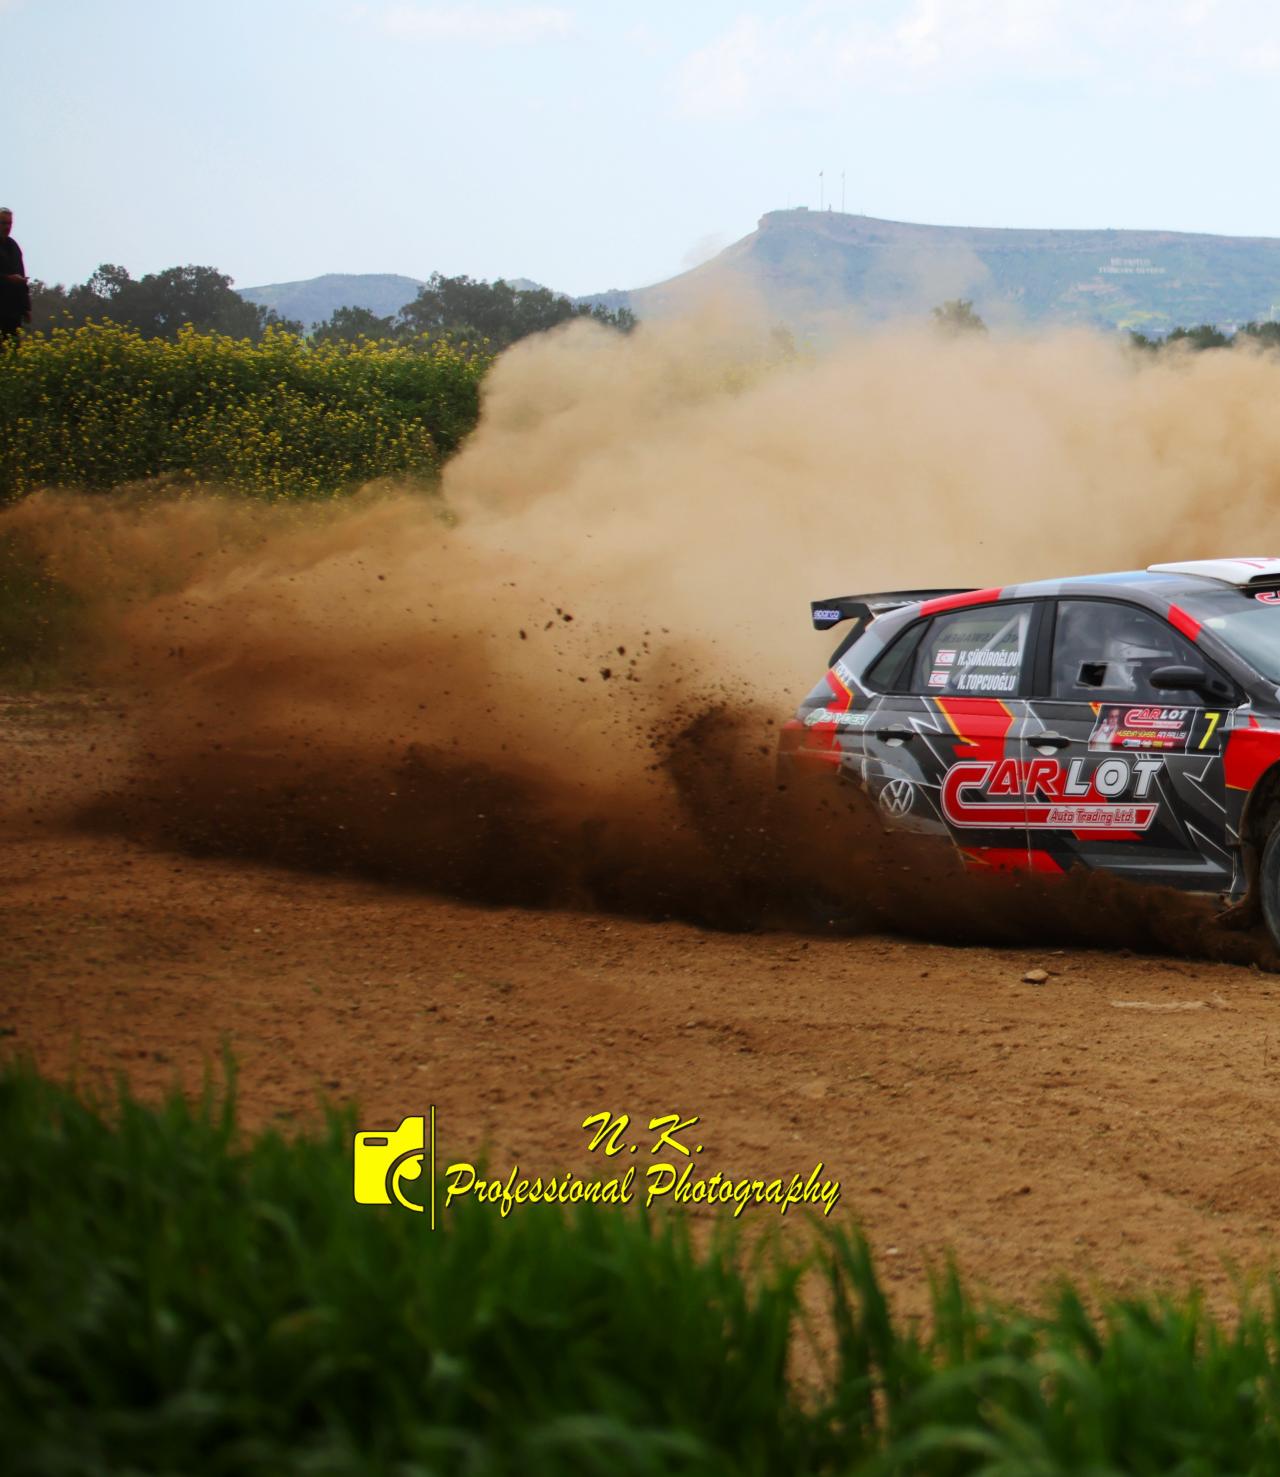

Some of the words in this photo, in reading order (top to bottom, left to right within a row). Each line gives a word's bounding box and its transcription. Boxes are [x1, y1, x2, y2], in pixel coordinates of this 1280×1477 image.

[1124, 709, 1188, 729] CARLOT
[1198, 713, 1220, 749] 7
[941, 758, 1164, 829] CARLOT
[1050, 809, 1074, 823] Auto
[1076, 809, 1112, 825] Trading
